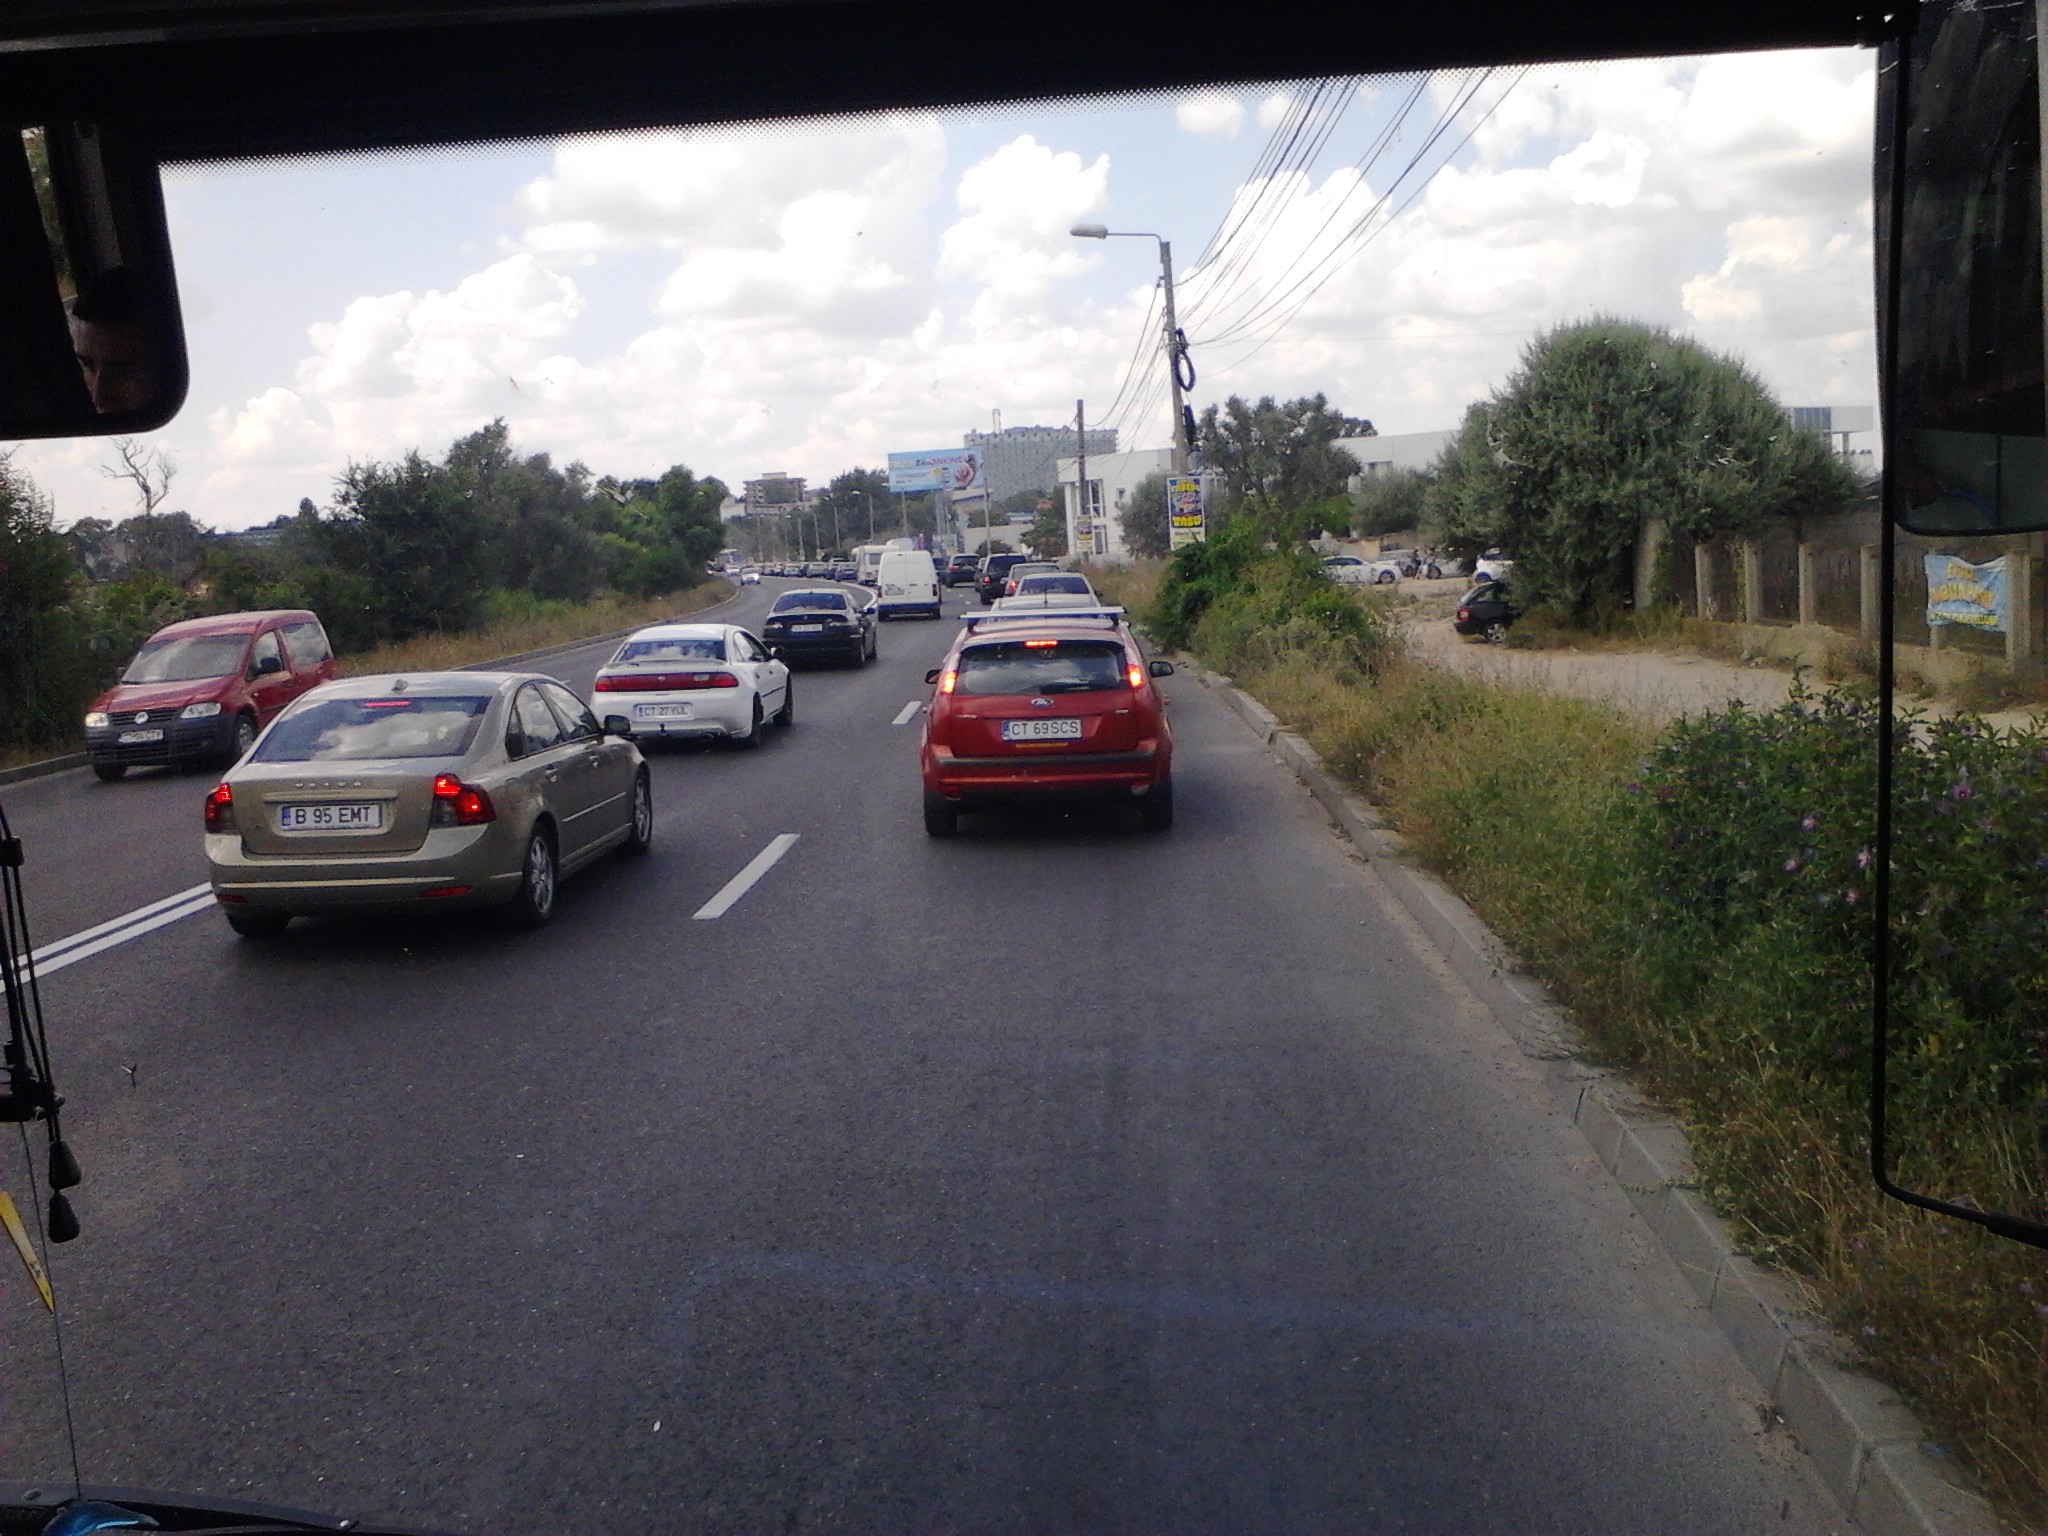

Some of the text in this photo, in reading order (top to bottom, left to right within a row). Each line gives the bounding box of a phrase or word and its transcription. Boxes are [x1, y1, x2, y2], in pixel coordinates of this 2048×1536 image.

[1011, 722, 1028, 736] CT
[295, 806, 371, 825] B 95 EMT
